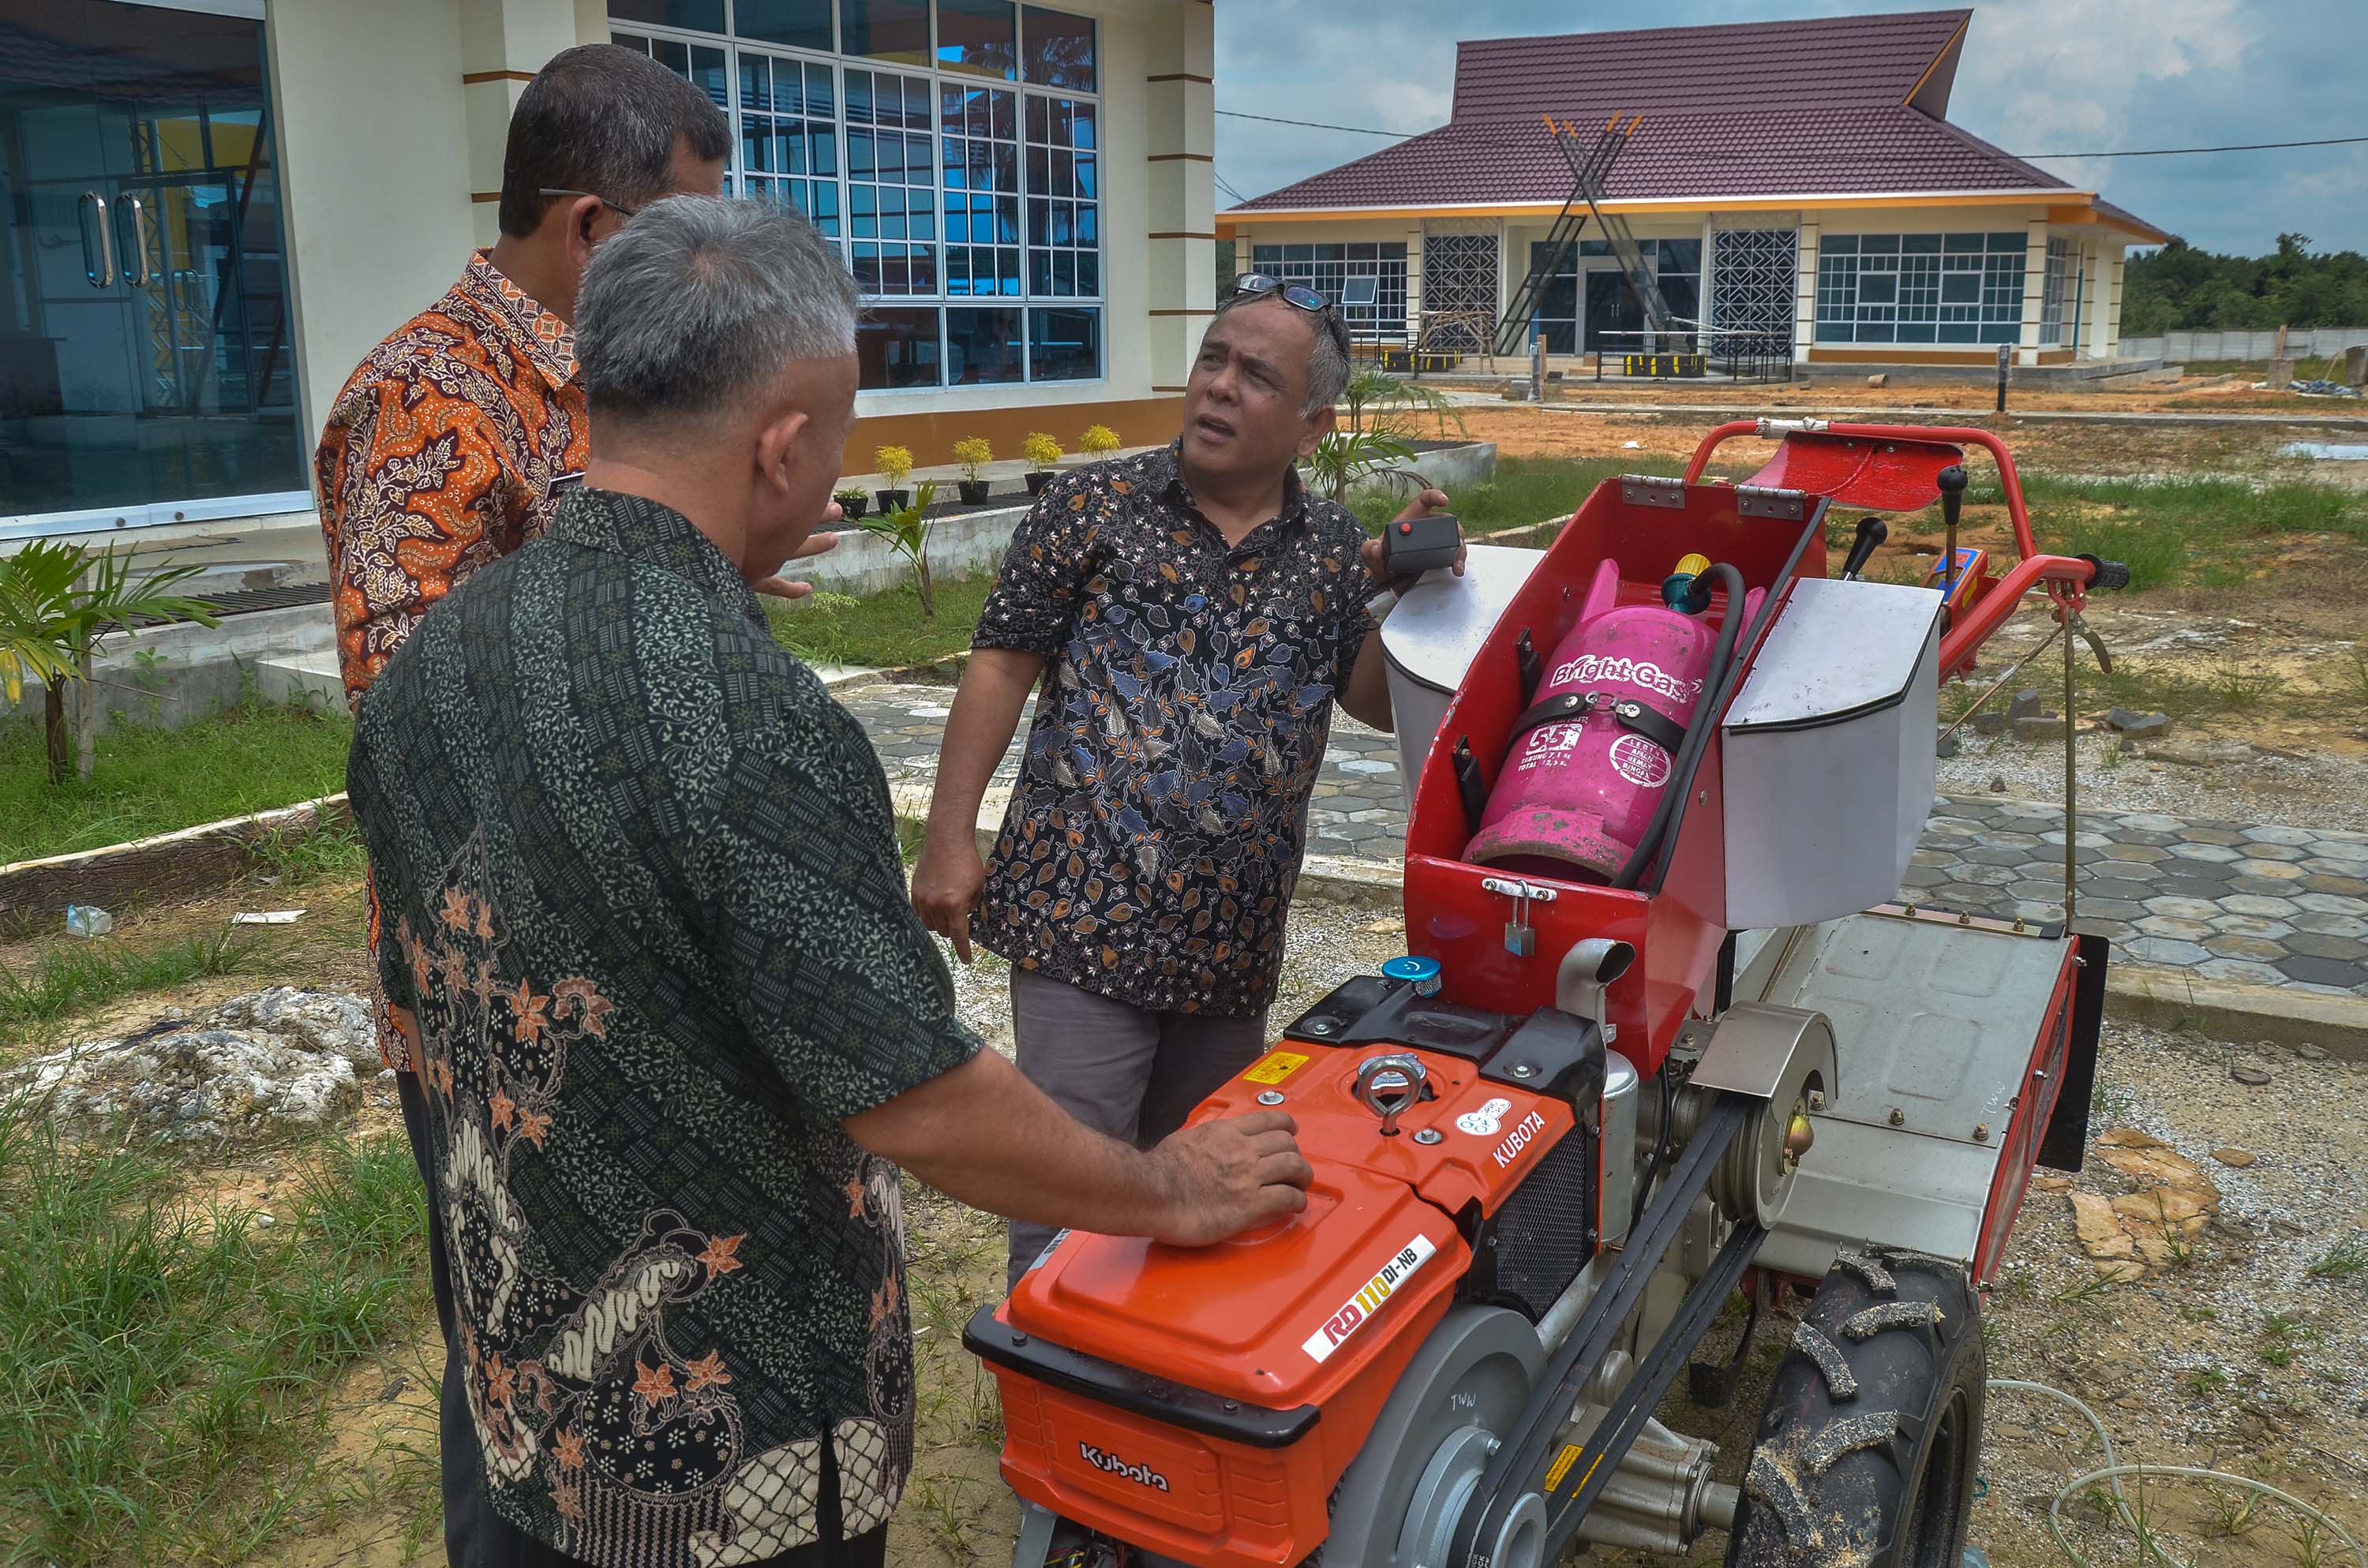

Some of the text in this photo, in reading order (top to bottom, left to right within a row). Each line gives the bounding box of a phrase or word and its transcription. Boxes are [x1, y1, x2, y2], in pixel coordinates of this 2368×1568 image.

[1549, 654, 1691, 703] Bright Gas
[1518, 762, 1537, 772] TOTAL
[1492, 1110, 1546, 1169] KUBOTA
[1079, 1439, 1169, 1492] Kubota
